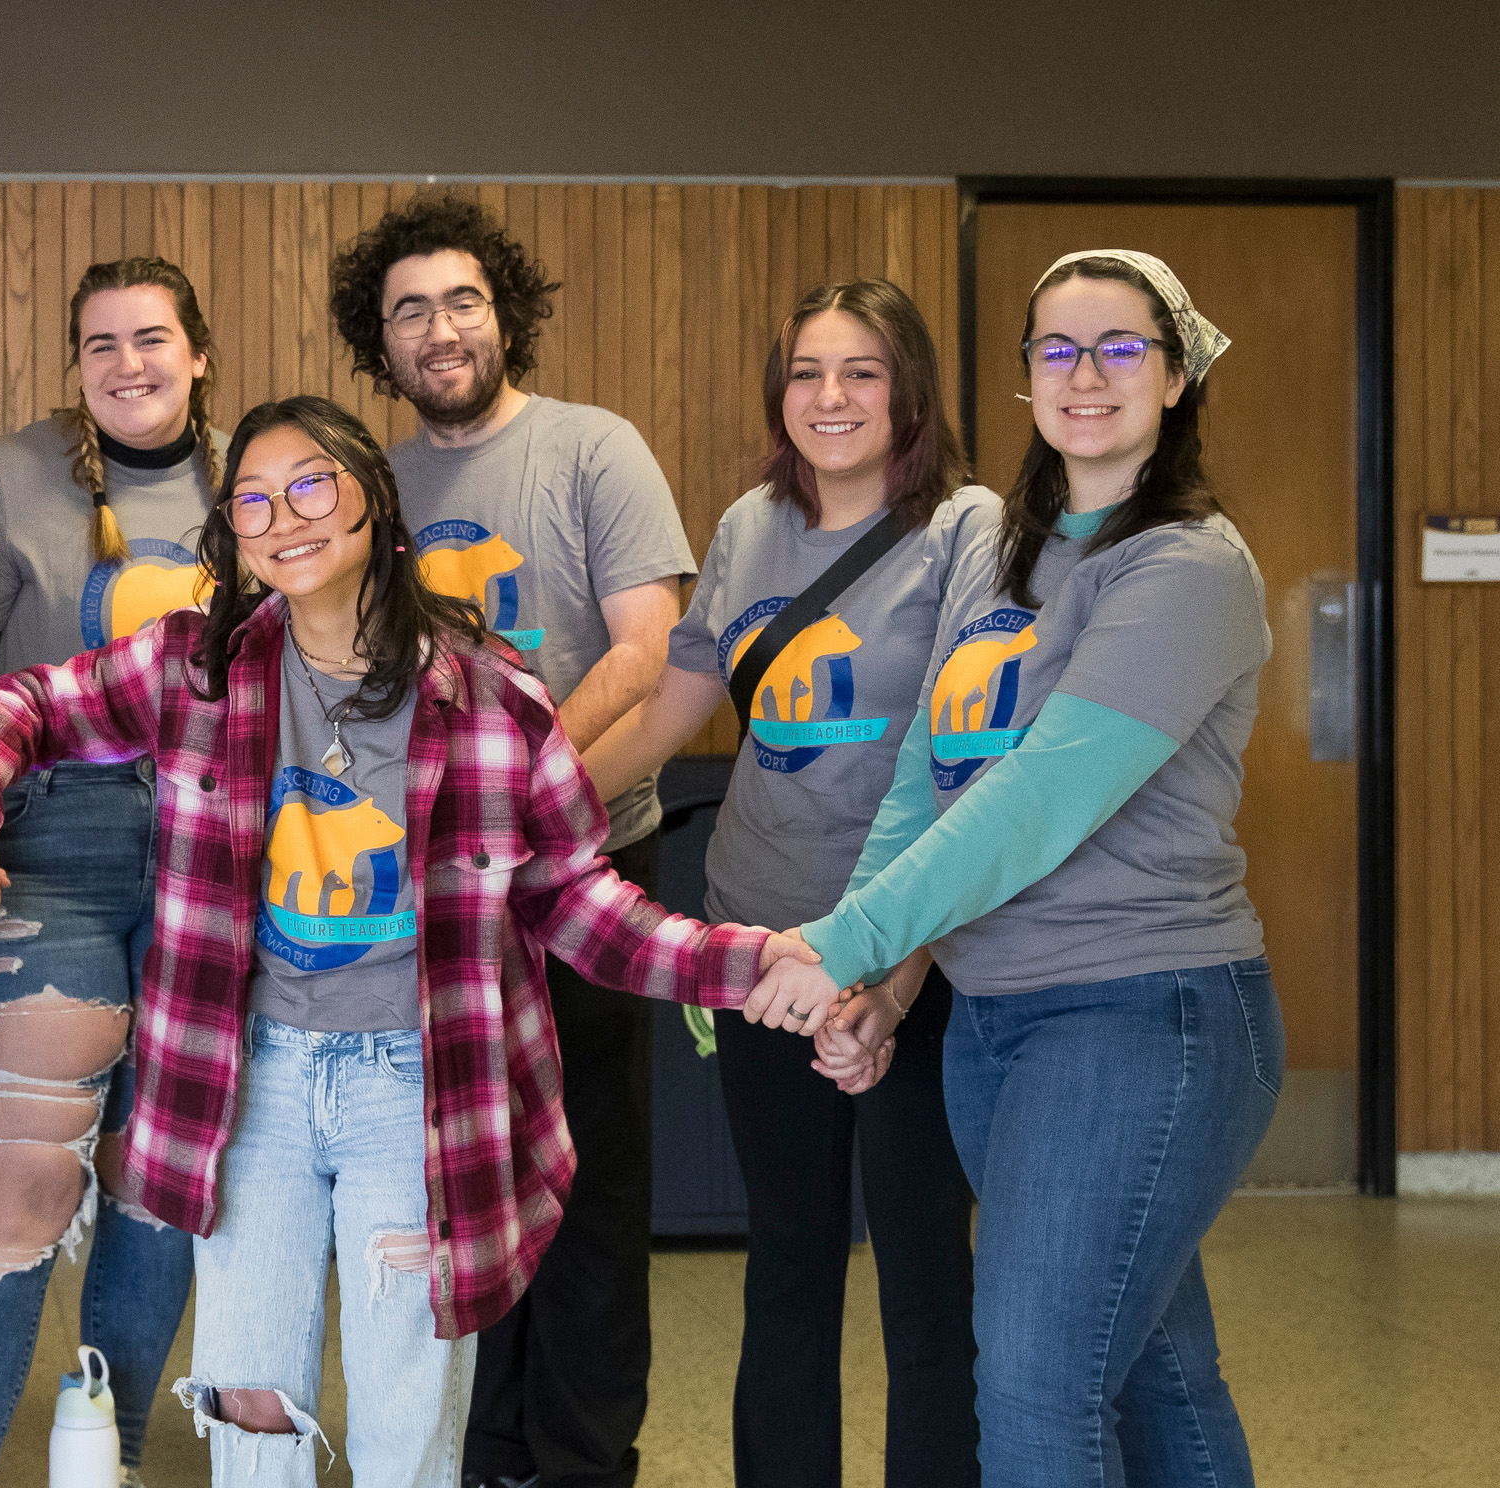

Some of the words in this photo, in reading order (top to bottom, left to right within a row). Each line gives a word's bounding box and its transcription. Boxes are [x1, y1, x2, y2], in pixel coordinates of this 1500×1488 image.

[415, 523, 477, 546] EACHING
[718, 627, 740, 663] UNC
[765, 725, 800, 742] FUTURE
[802, 723, 873, 741] TEACHERS
[286, 917, 336, 937] FUTURE
[340, 917, 415, 937] TEACHERS
